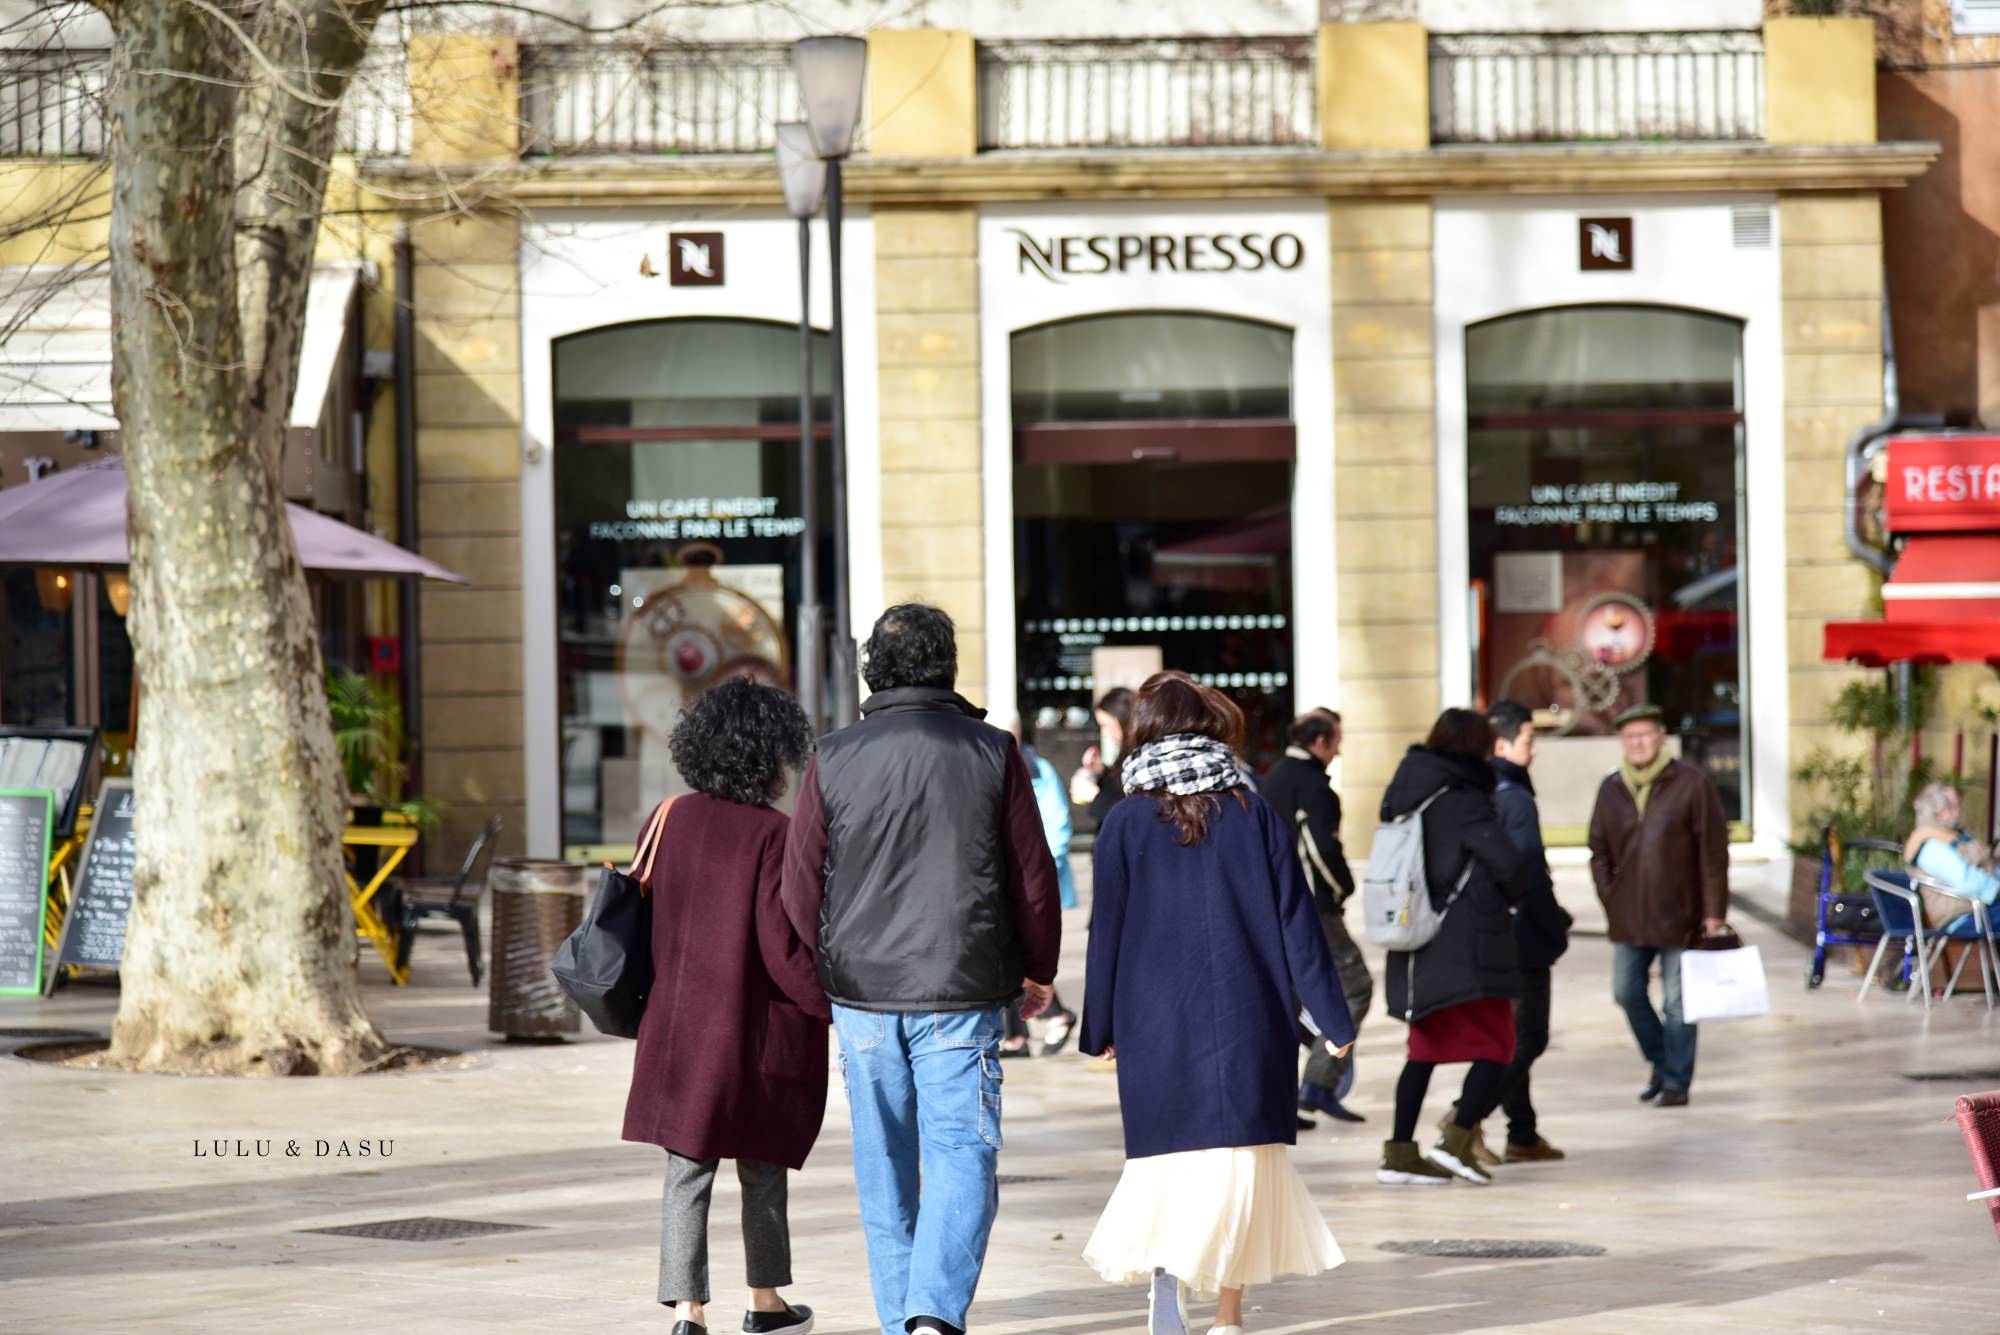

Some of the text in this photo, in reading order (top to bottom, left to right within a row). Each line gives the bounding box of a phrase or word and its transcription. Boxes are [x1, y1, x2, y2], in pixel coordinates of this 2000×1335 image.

[1004, 228, 1306, 284] NESPRESSO
[1531, 484, 1562, 503] UN
[626, 500, 657, 519] UN
[1585, 503, 1625, 523] PAR
[1626, 503, 1650, 522] LE
[1654, 501, 1718, 522] TEMPS
[681, 518, 722, 539] PAR
[723, 518, 749, 538] LE
